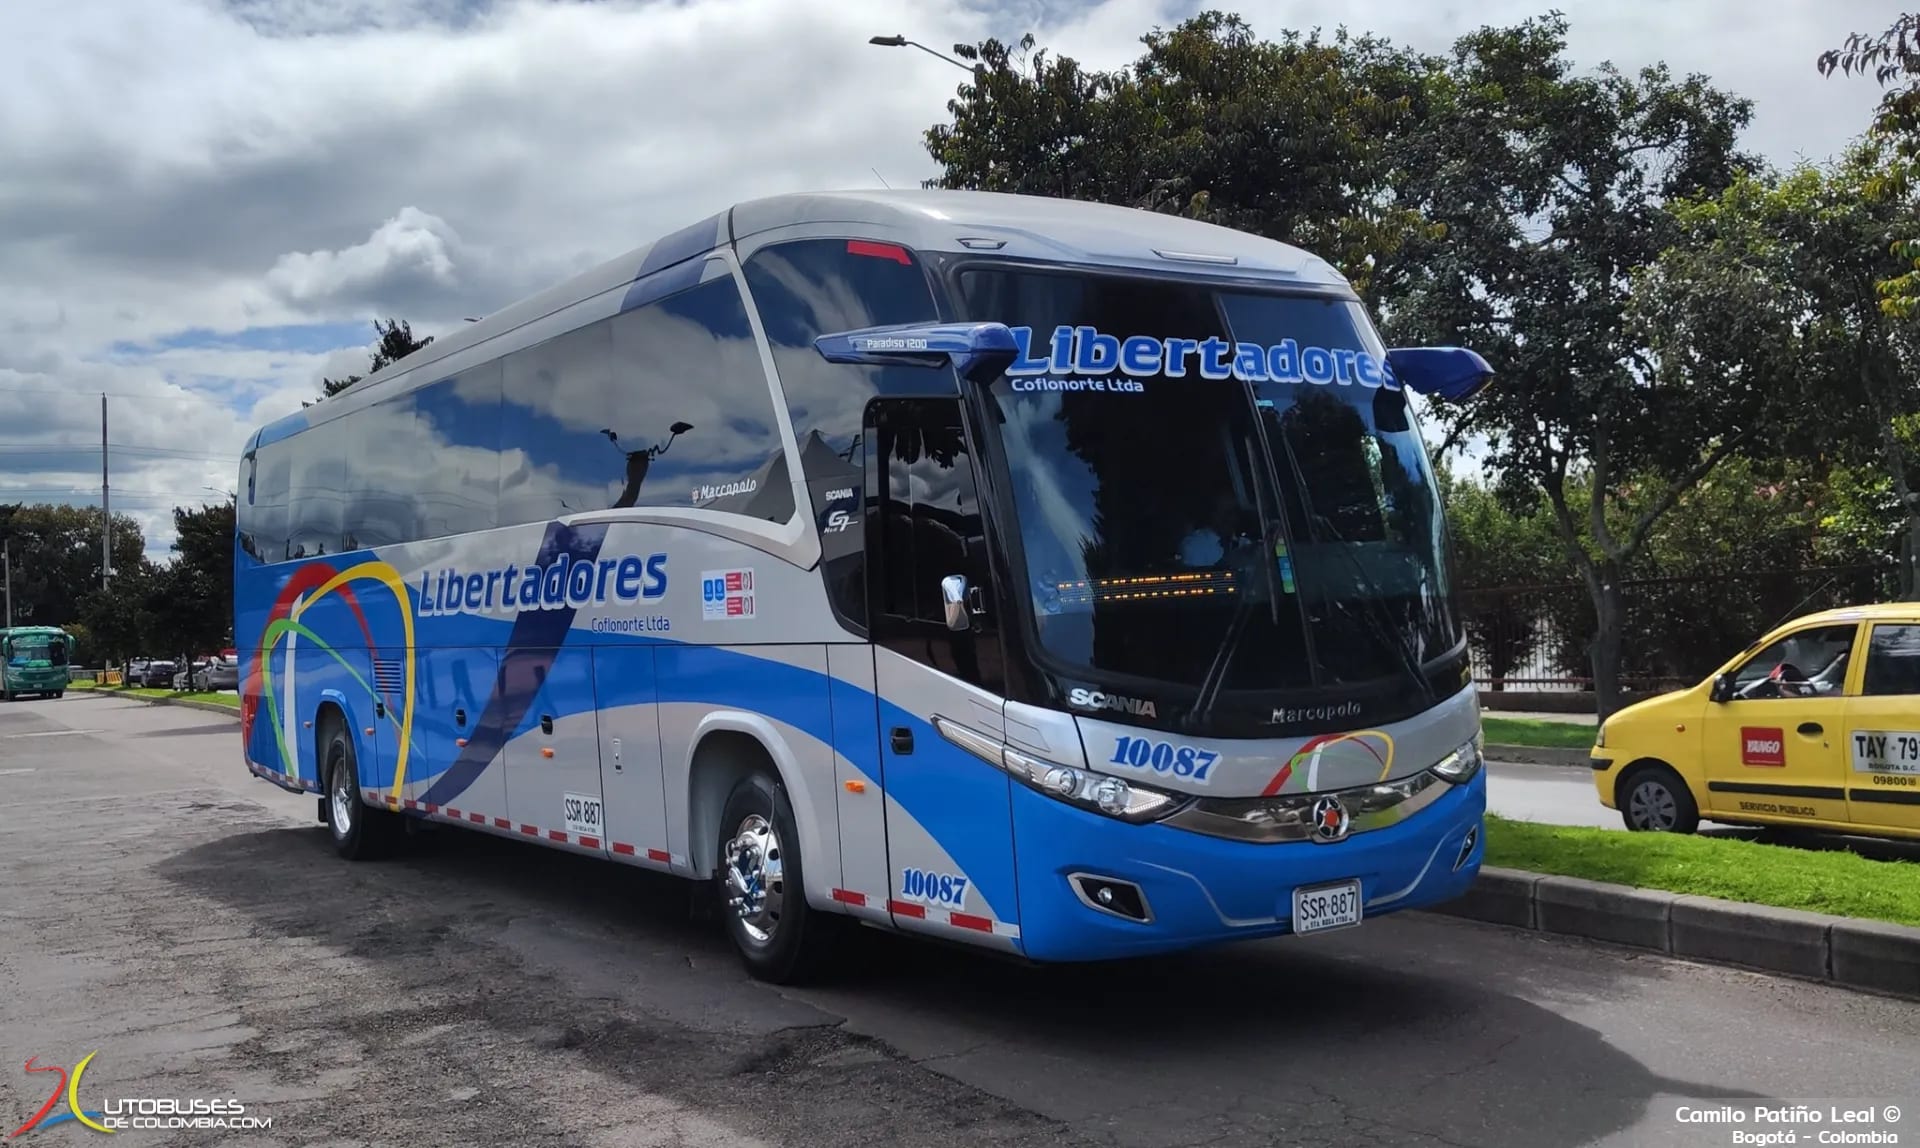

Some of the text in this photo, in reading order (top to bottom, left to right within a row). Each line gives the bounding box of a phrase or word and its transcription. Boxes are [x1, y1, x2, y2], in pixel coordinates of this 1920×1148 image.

[867, 337, 927, 349] Paradiso 1200
[1005, 325, 1401, 392] Libertadores
[1011, 378, 1145, 392] Coflonorte Ltda
[701, 478, 757, 500] Marcopolo
[825, 488, 854, 501] SCANIA
[417, 552, 669, 617] Libertadores
[591, 615, 671, 633] Coflonorte Ltda
[1069, 687, 1157, 718] SCANIA
[1271, 701, 1361, 724] Marcopolo
[1747, 739, 1781, 754] YANGO
[1109, 736, 1219, 781] 10087
[565, 798, 601, 826] SSR 887
[1739, 801, 1778, 812] SERVICIO
[902, 868, 968, 905] 10087
